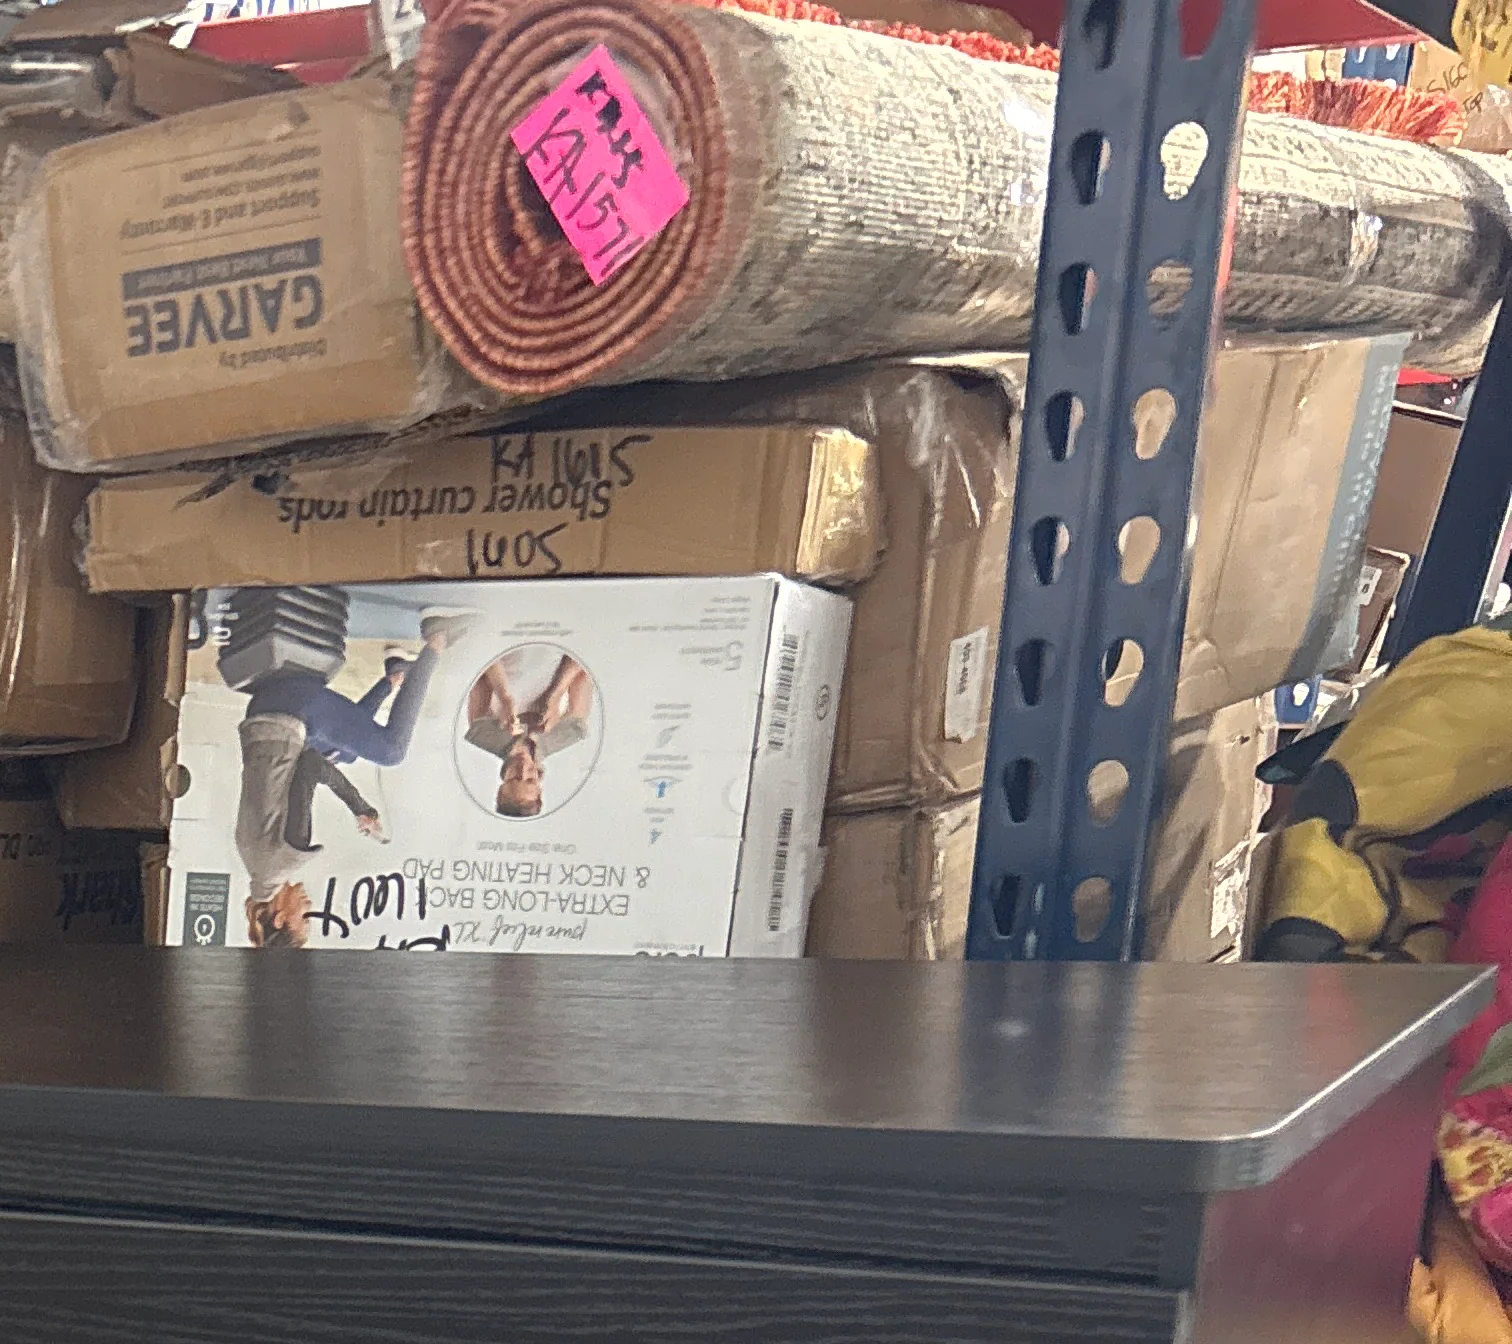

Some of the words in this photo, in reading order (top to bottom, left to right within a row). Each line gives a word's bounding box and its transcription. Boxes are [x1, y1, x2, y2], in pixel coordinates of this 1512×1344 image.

[124, 273, 325, 358] GARVEE
[277, 496, 349, 535] rods
[359, 484, 476, 527] curtain
[481, 479, 613, 522] Shower
[402, 857, 446, 881] PAD
[453, 859, 553, 886] HEATING
[558, 863, 626, 888] NECK
[637, 866, 651, 889] &
[482, 887, 631, 917] EXTRA-LONG
